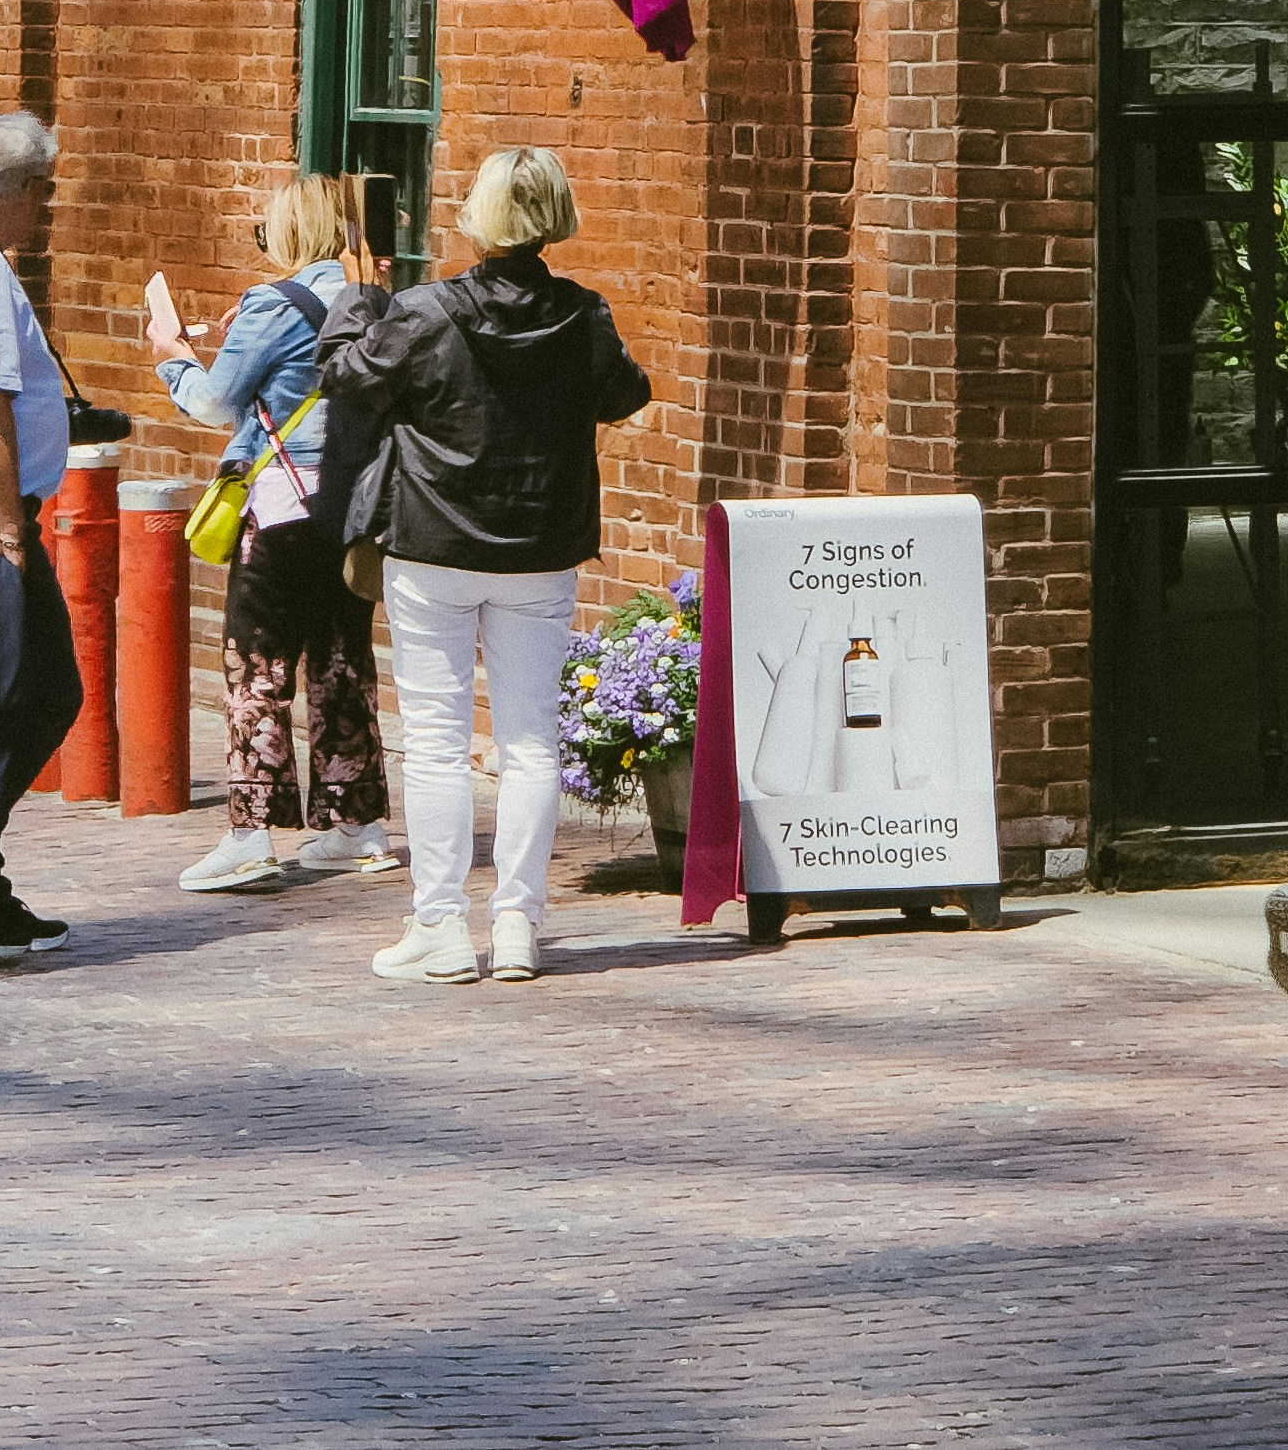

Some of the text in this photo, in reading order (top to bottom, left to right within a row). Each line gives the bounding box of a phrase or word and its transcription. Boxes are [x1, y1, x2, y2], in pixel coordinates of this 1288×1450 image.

[802, 538, 915, 566] 7 Signs of
[789, 567, 927, 595] Congestion.
[779, 812, 958, 844] 7 Skin-Clearing
